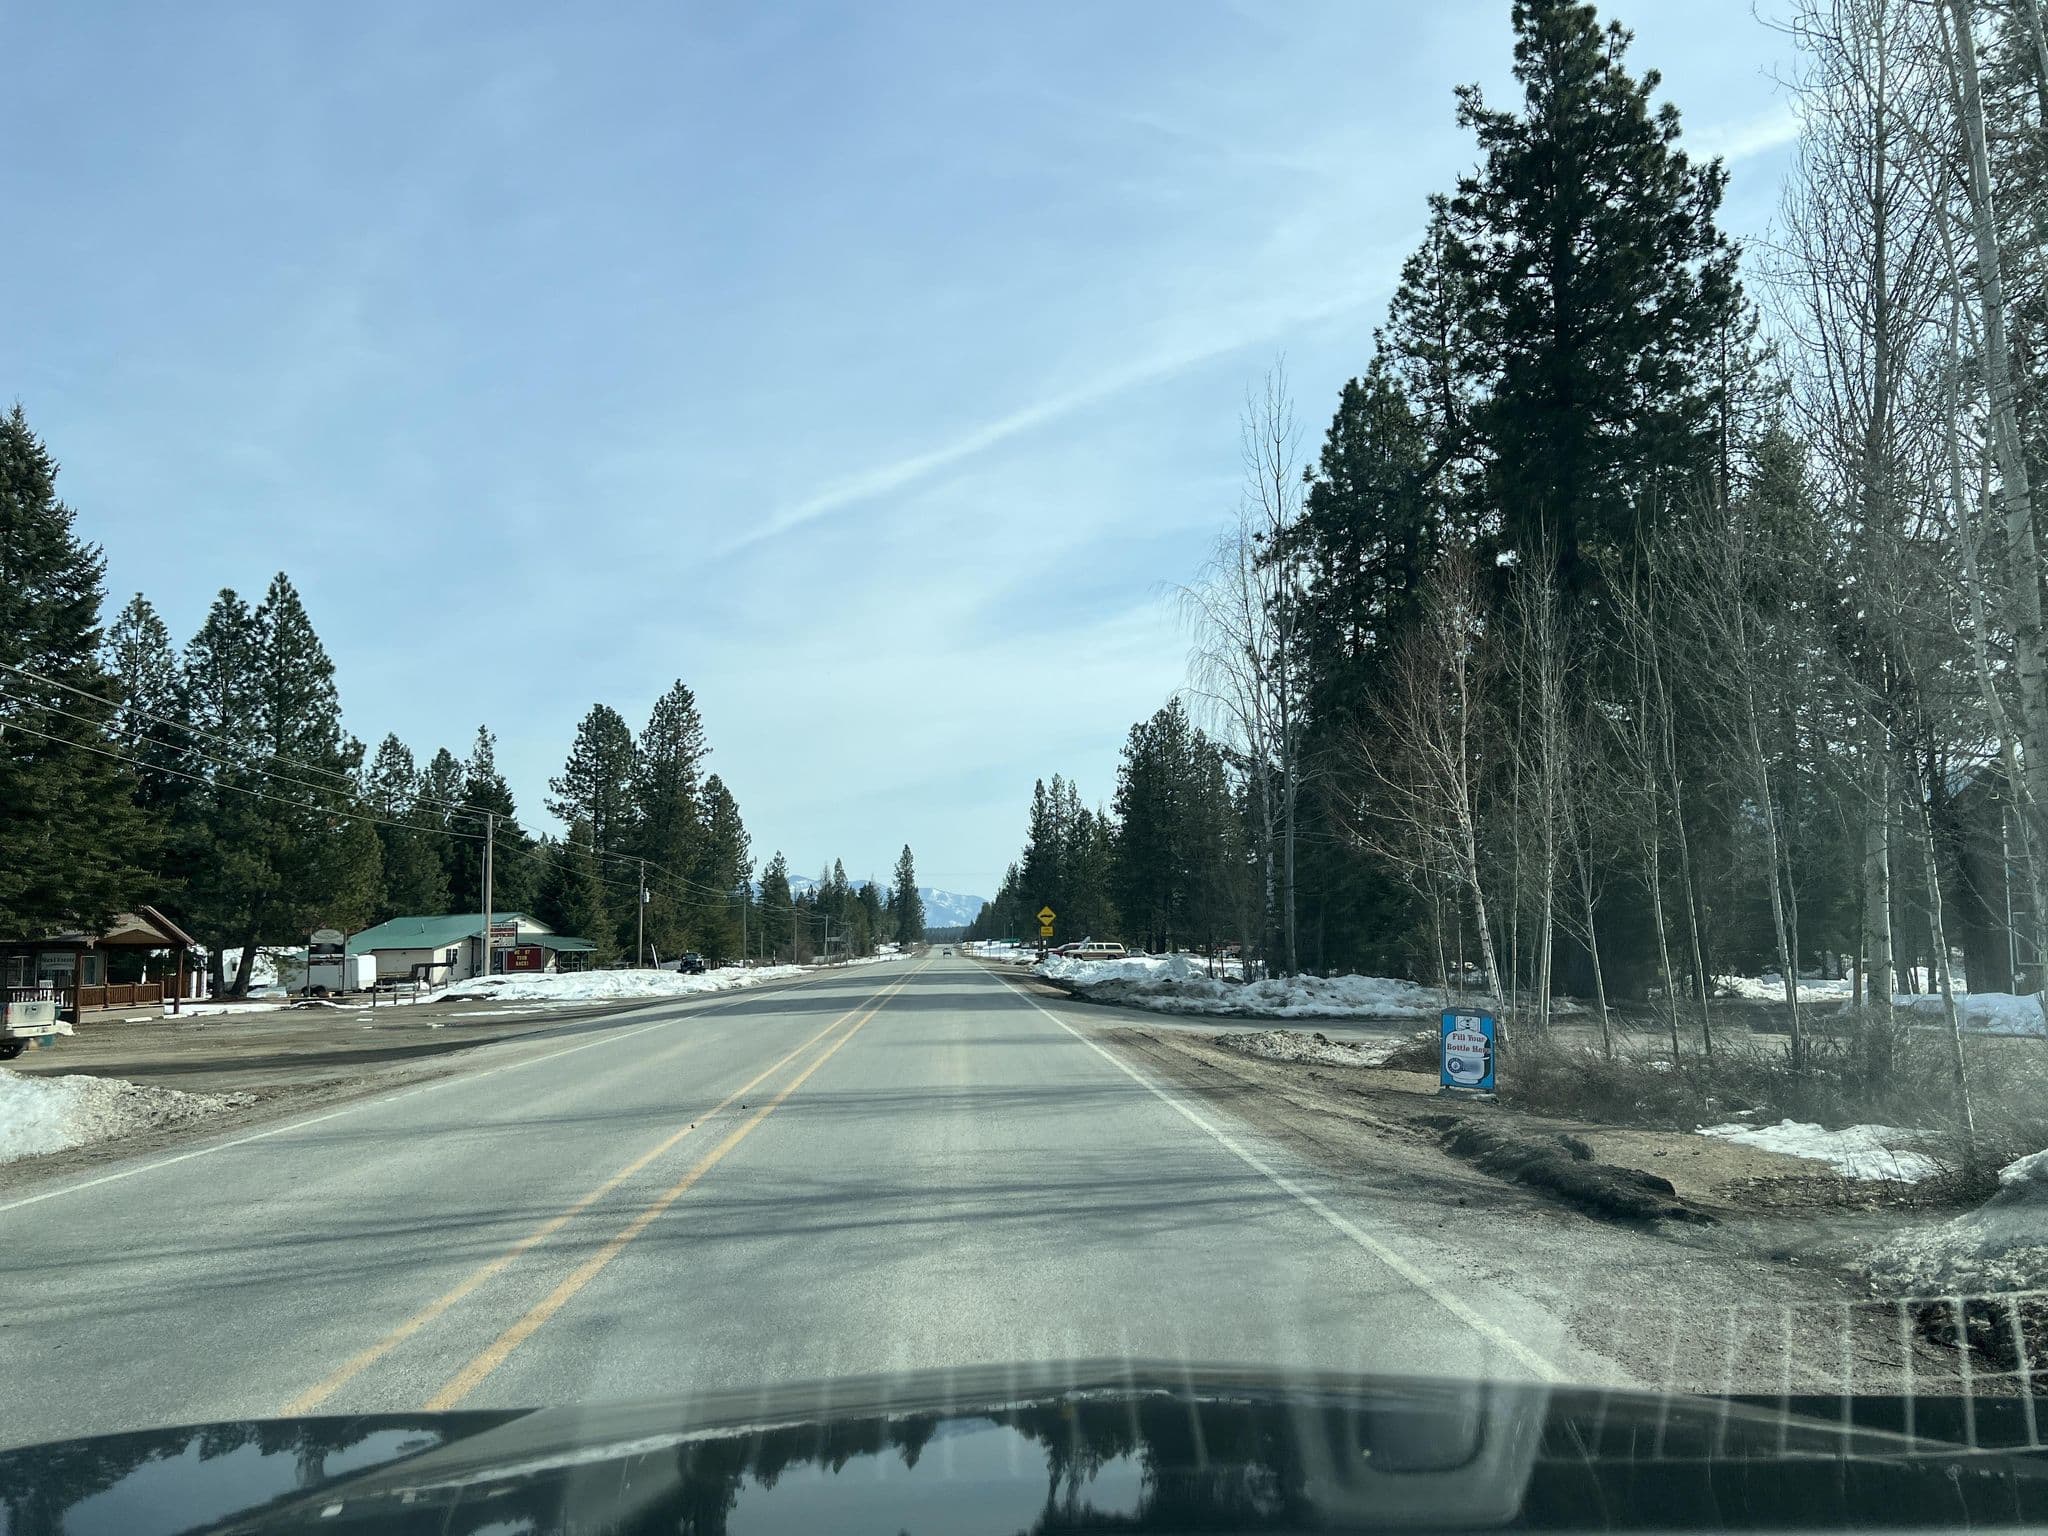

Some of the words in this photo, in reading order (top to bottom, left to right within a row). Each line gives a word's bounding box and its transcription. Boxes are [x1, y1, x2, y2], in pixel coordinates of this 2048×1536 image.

[1452, 1032, 1465, 1041] Fill
[1467, 1034, 1486, 1043] Your
[1447, 1043, 1471, 1052] Bottle
